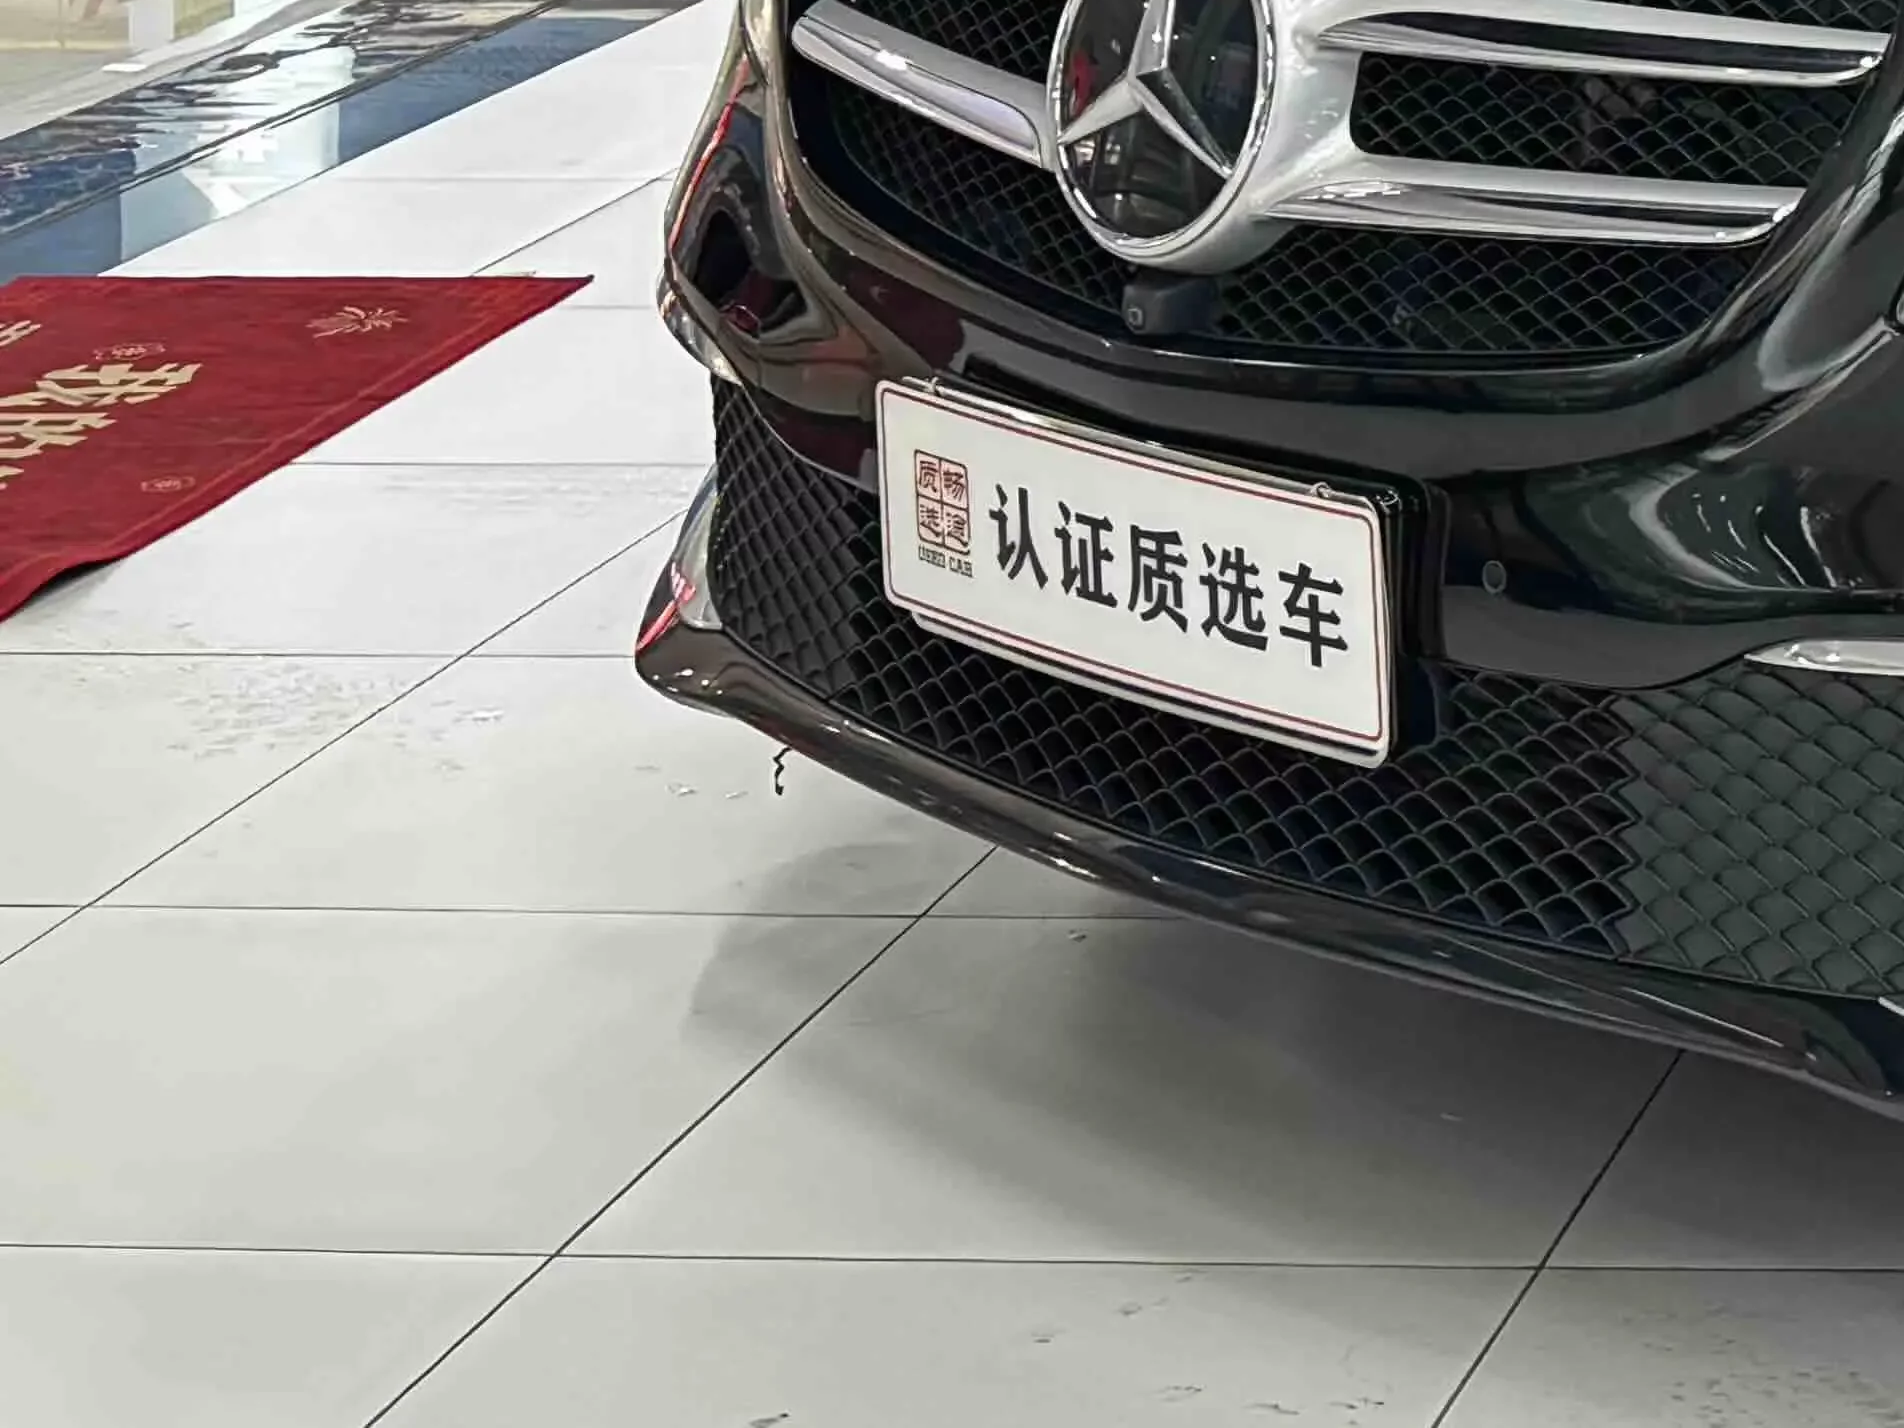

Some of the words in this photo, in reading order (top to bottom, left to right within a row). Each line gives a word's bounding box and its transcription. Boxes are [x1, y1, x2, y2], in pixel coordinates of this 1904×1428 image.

[988, 483, 1349, 669] 认证质选车
